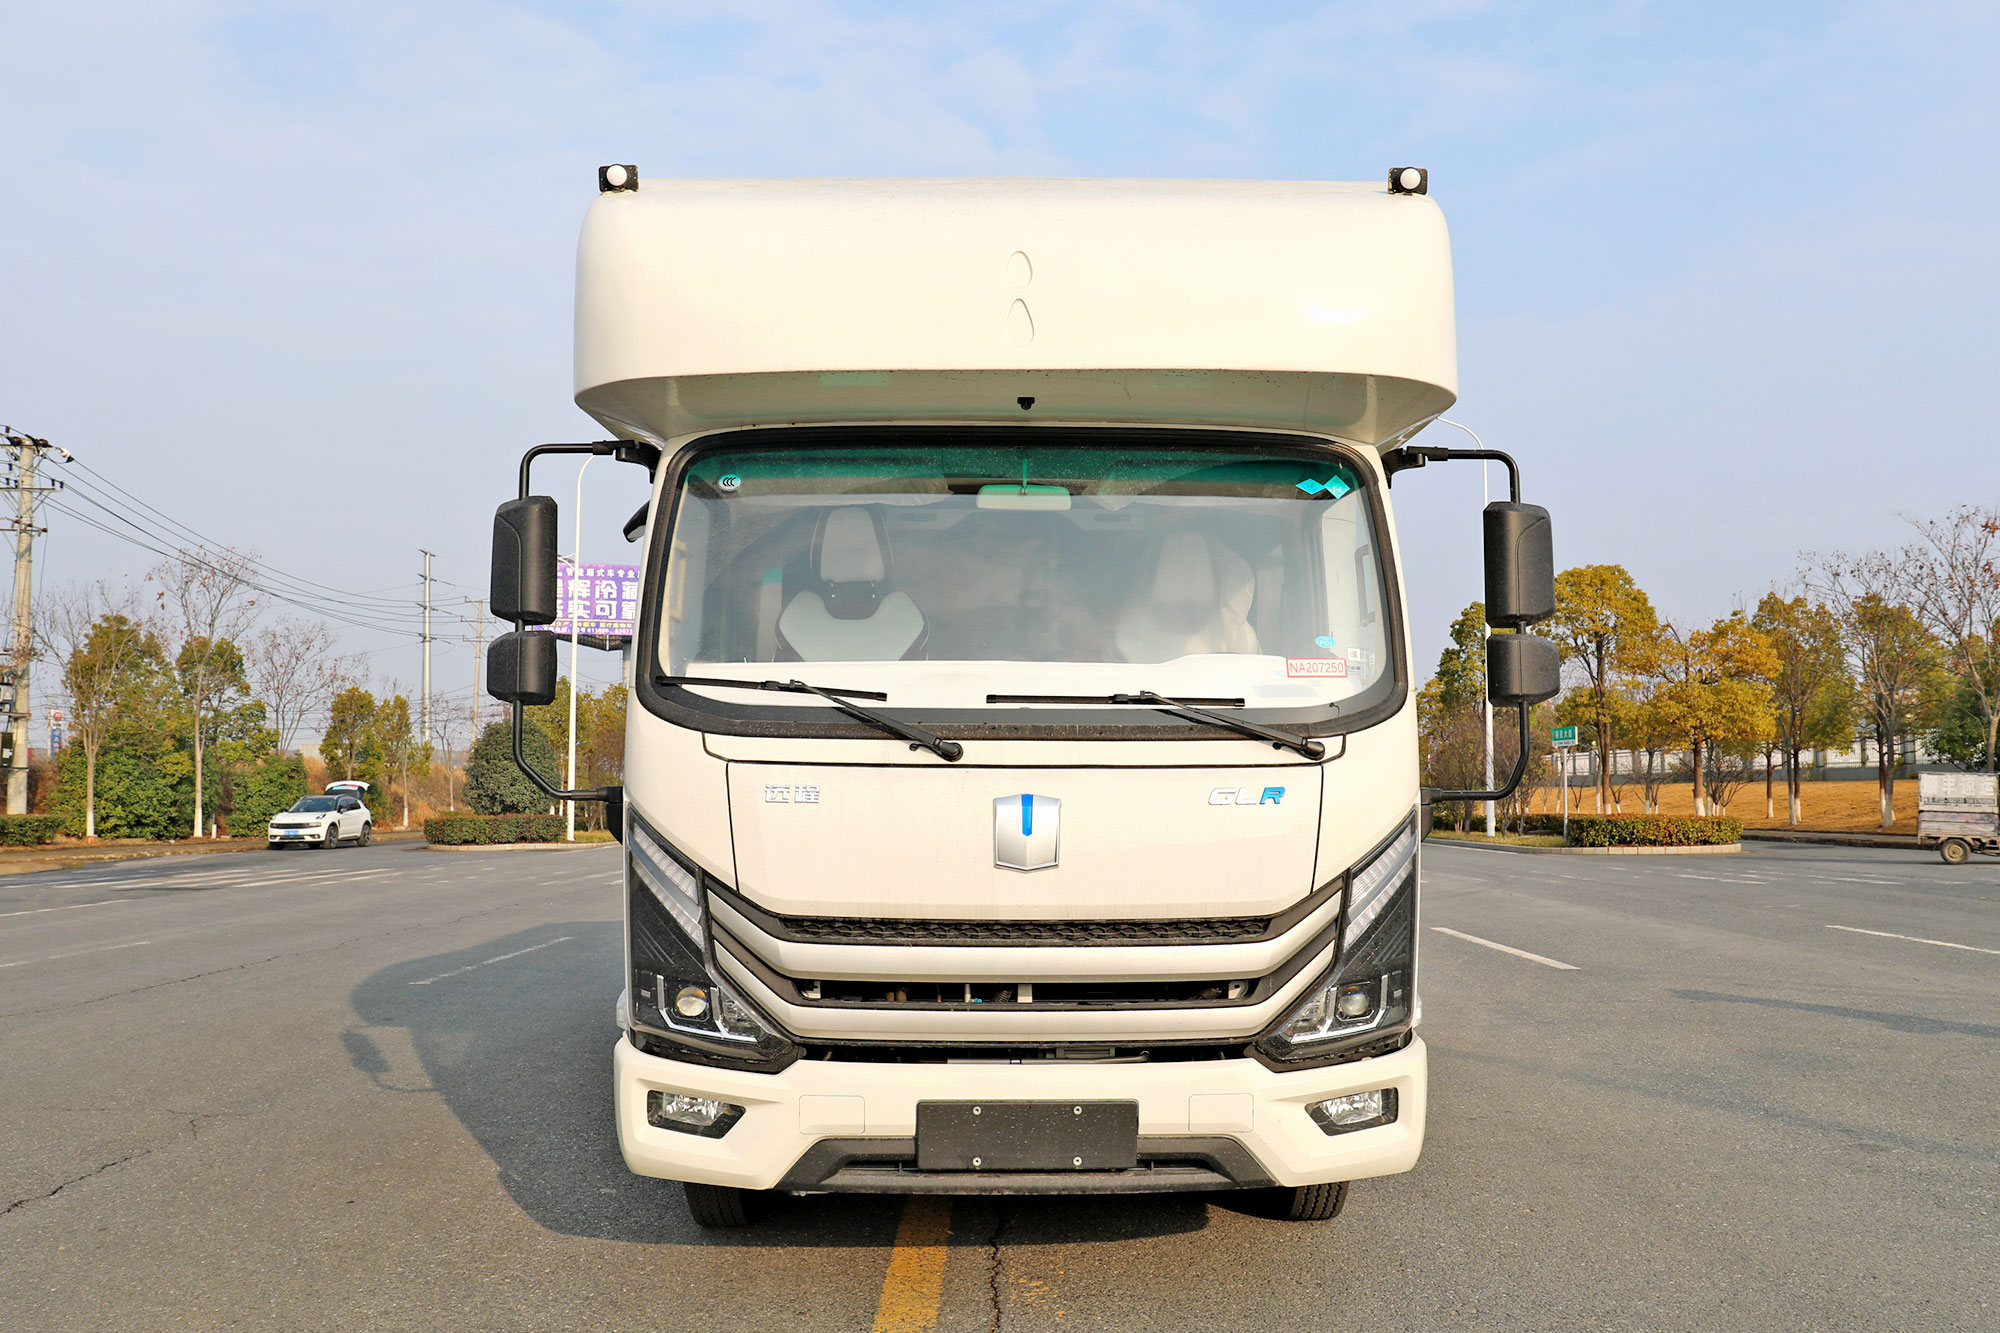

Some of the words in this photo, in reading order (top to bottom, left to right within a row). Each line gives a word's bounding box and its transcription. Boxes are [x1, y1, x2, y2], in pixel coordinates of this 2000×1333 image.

[557, 579, 638, 600] 辉冷藏
[557, 600, 636, 620] 实可靠
[1289, 662, 1344, 674] NA207250
[764, 784, 820, 804] 远程
[1208, 786, 1286, 806] GLR
